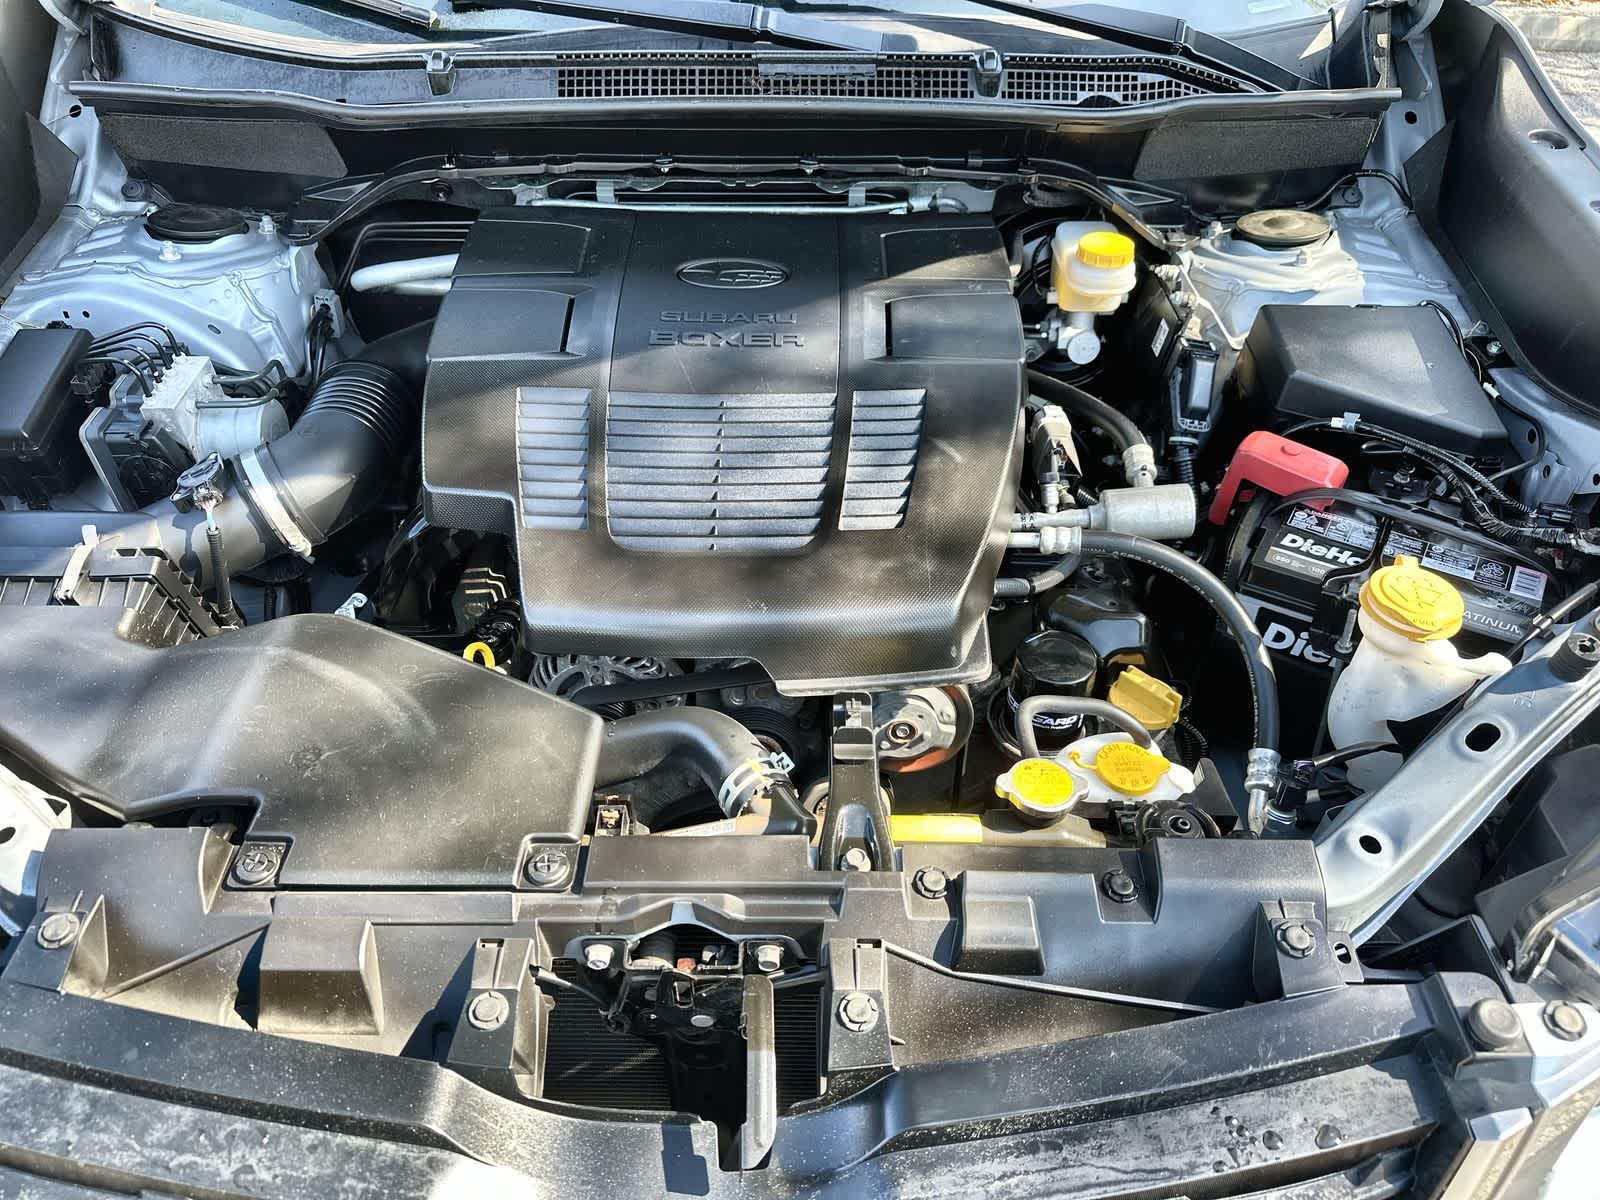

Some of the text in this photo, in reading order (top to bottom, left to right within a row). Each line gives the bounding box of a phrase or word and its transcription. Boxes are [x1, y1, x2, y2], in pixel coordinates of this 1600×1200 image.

[660, 311, 797, 324] SUBARU
[648, 330, 804, 347] BOXER
[1463, 610, 1522, 635] ATINUM
[1263, 622, 1337, 668] Die
[1032, 713, 1078, 726] GARD
